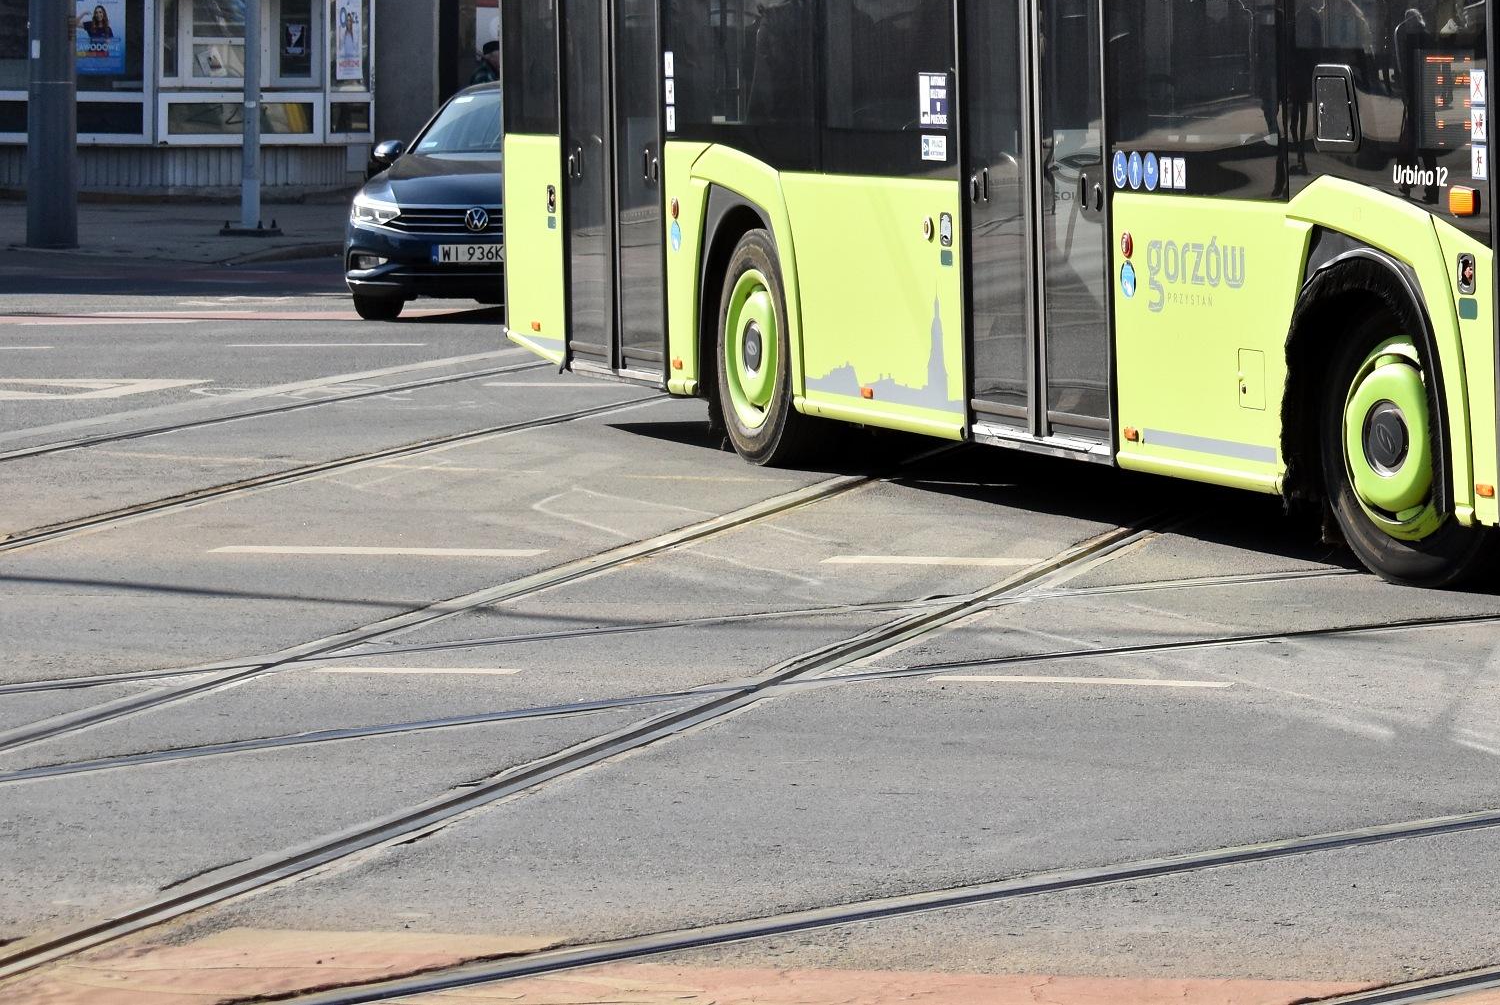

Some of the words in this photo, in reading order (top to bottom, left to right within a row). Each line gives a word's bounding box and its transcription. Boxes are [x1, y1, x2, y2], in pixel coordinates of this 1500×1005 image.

[78, 43, 120, 52] AWODOWE
[1393, 164, 1434, 186] Urbino
[1435, 166, 1449, 187] 12
[442, 246, 459, 262] WI
[1146, 236, 1246, 313] gorzów
